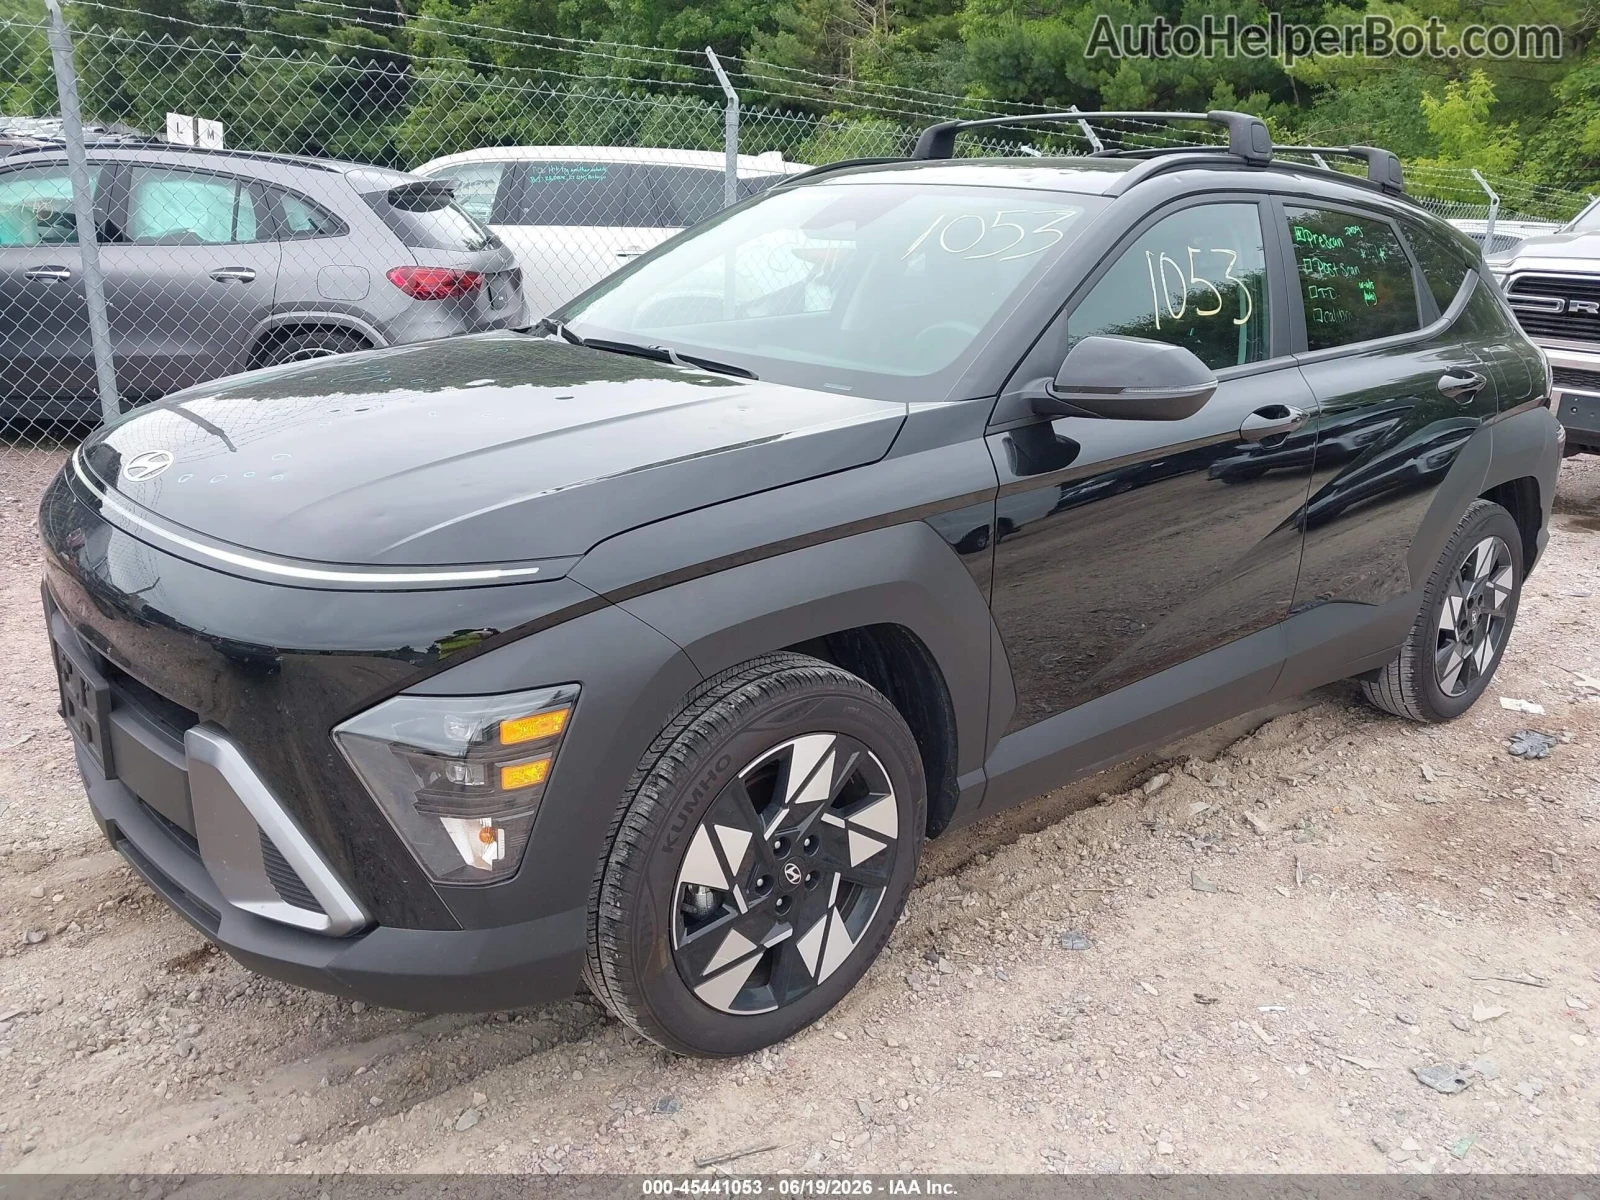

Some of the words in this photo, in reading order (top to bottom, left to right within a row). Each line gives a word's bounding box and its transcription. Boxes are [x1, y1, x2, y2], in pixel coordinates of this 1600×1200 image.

[206, 127, 215, 140] M
[901, 209, 1079, 262] 1053
[1145, 246, 1252, 330] 1053
[661, 753, 732, 853] KUMHO
